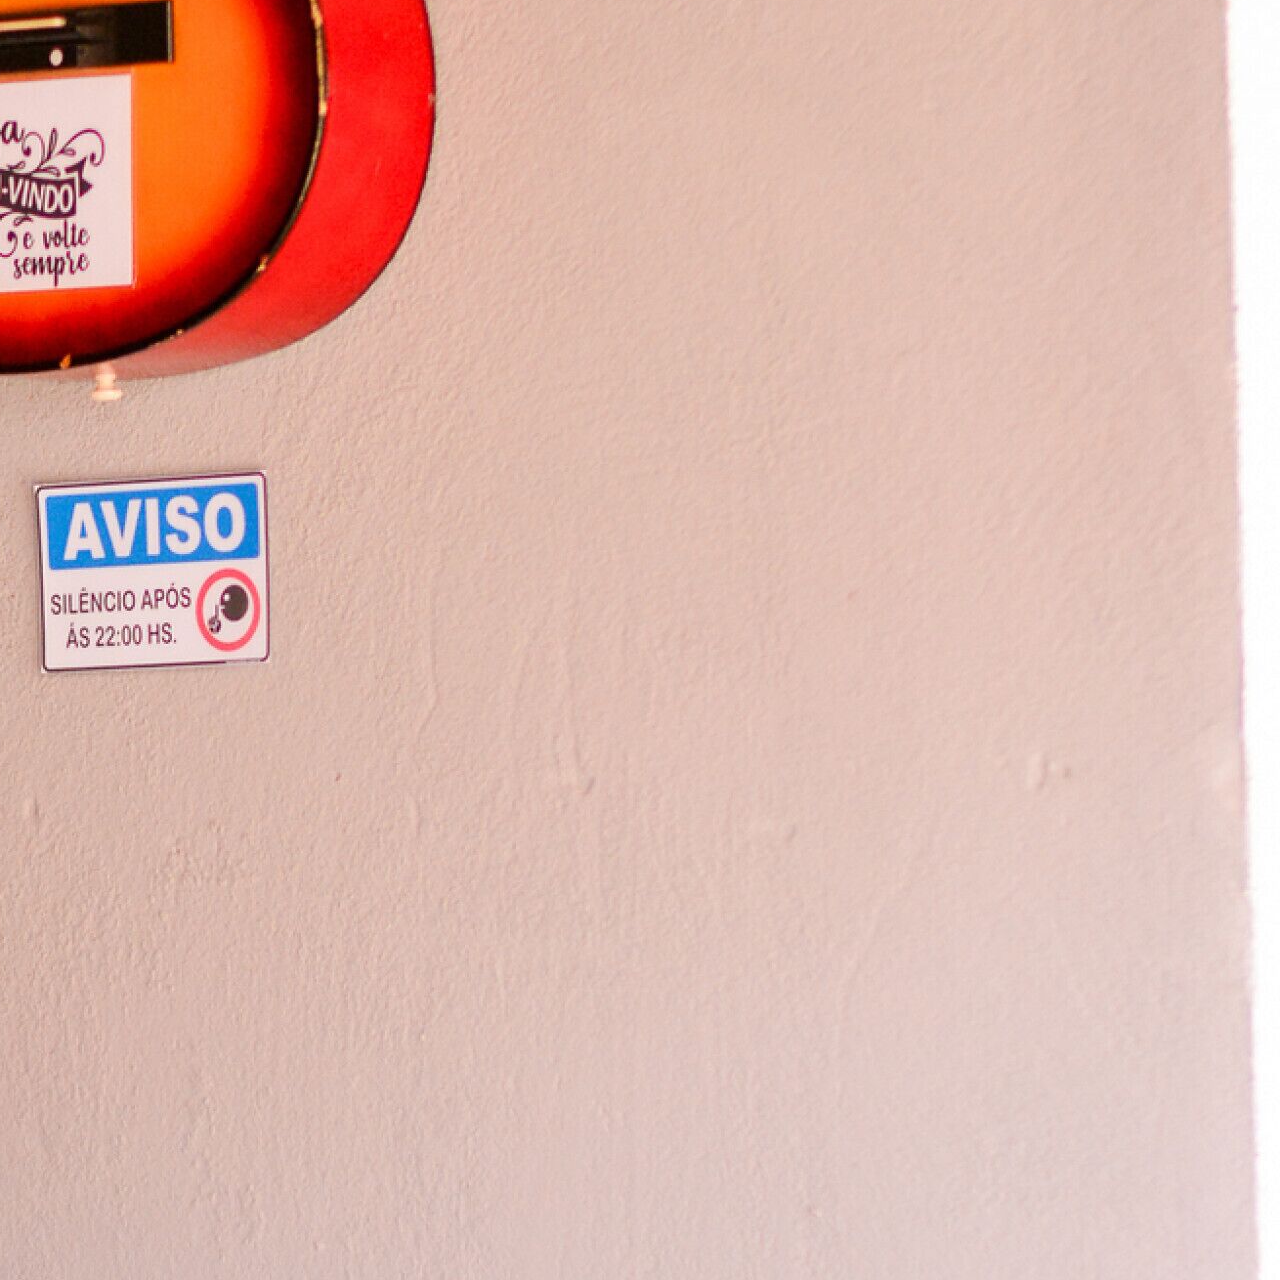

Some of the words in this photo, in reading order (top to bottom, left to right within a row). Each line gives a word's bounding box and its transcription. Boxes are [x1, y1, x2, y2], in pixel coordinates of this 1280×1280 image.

[22, 231, 35, 249] e
[43, 219, 91, 250] volte
[13, 251, 91, 287] sempre
[63, 492, 246, 561] AVISO
[50, 587, 136, 615] SILÊNCIO
[140, 582, 192, 610] APÓS
[95, 624, 144, 647] 22:00
[147, 622, 177, 645] HS.
